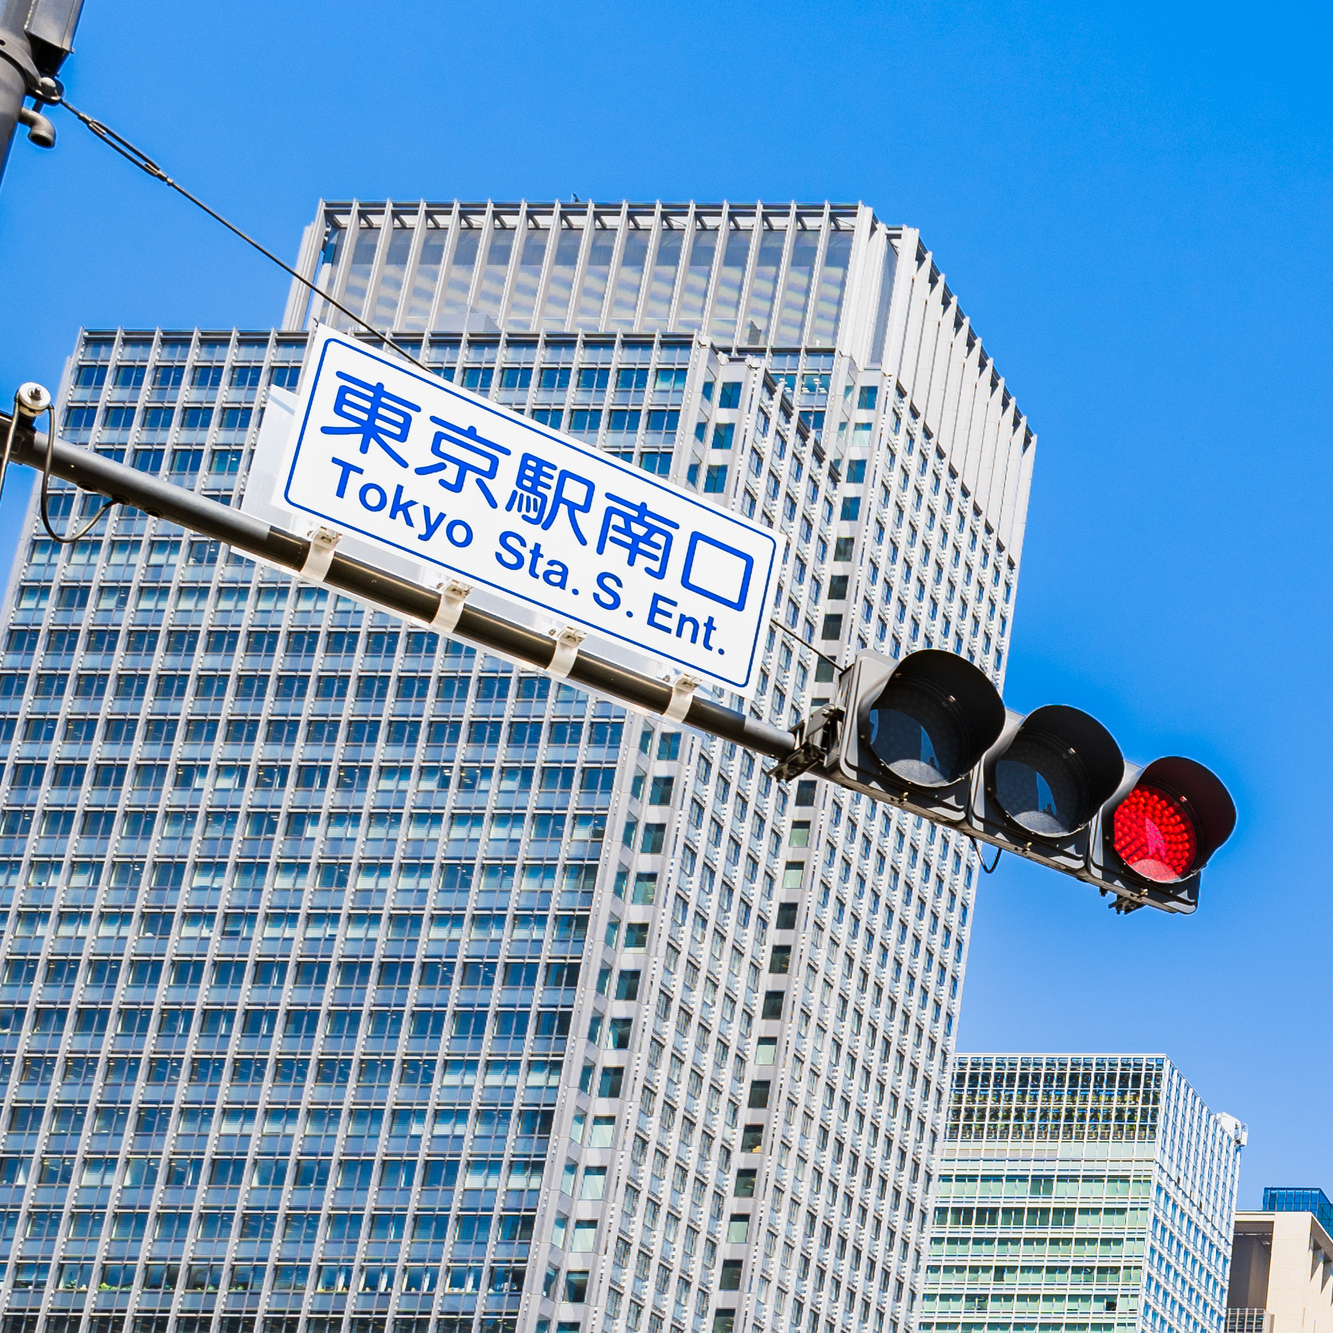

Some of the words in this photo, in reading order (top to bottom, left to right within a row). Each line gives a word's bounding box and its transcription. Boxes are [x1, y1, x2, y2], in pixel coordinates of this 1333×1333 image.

[320, 370, 754, 612] 東京駅南口
[330, 457, 474, 549] Tokyo
[494, 530, 580, 596] Sta.
[592, 572, 634, 618] S.
[646, 594, 726, 656] Ent.
